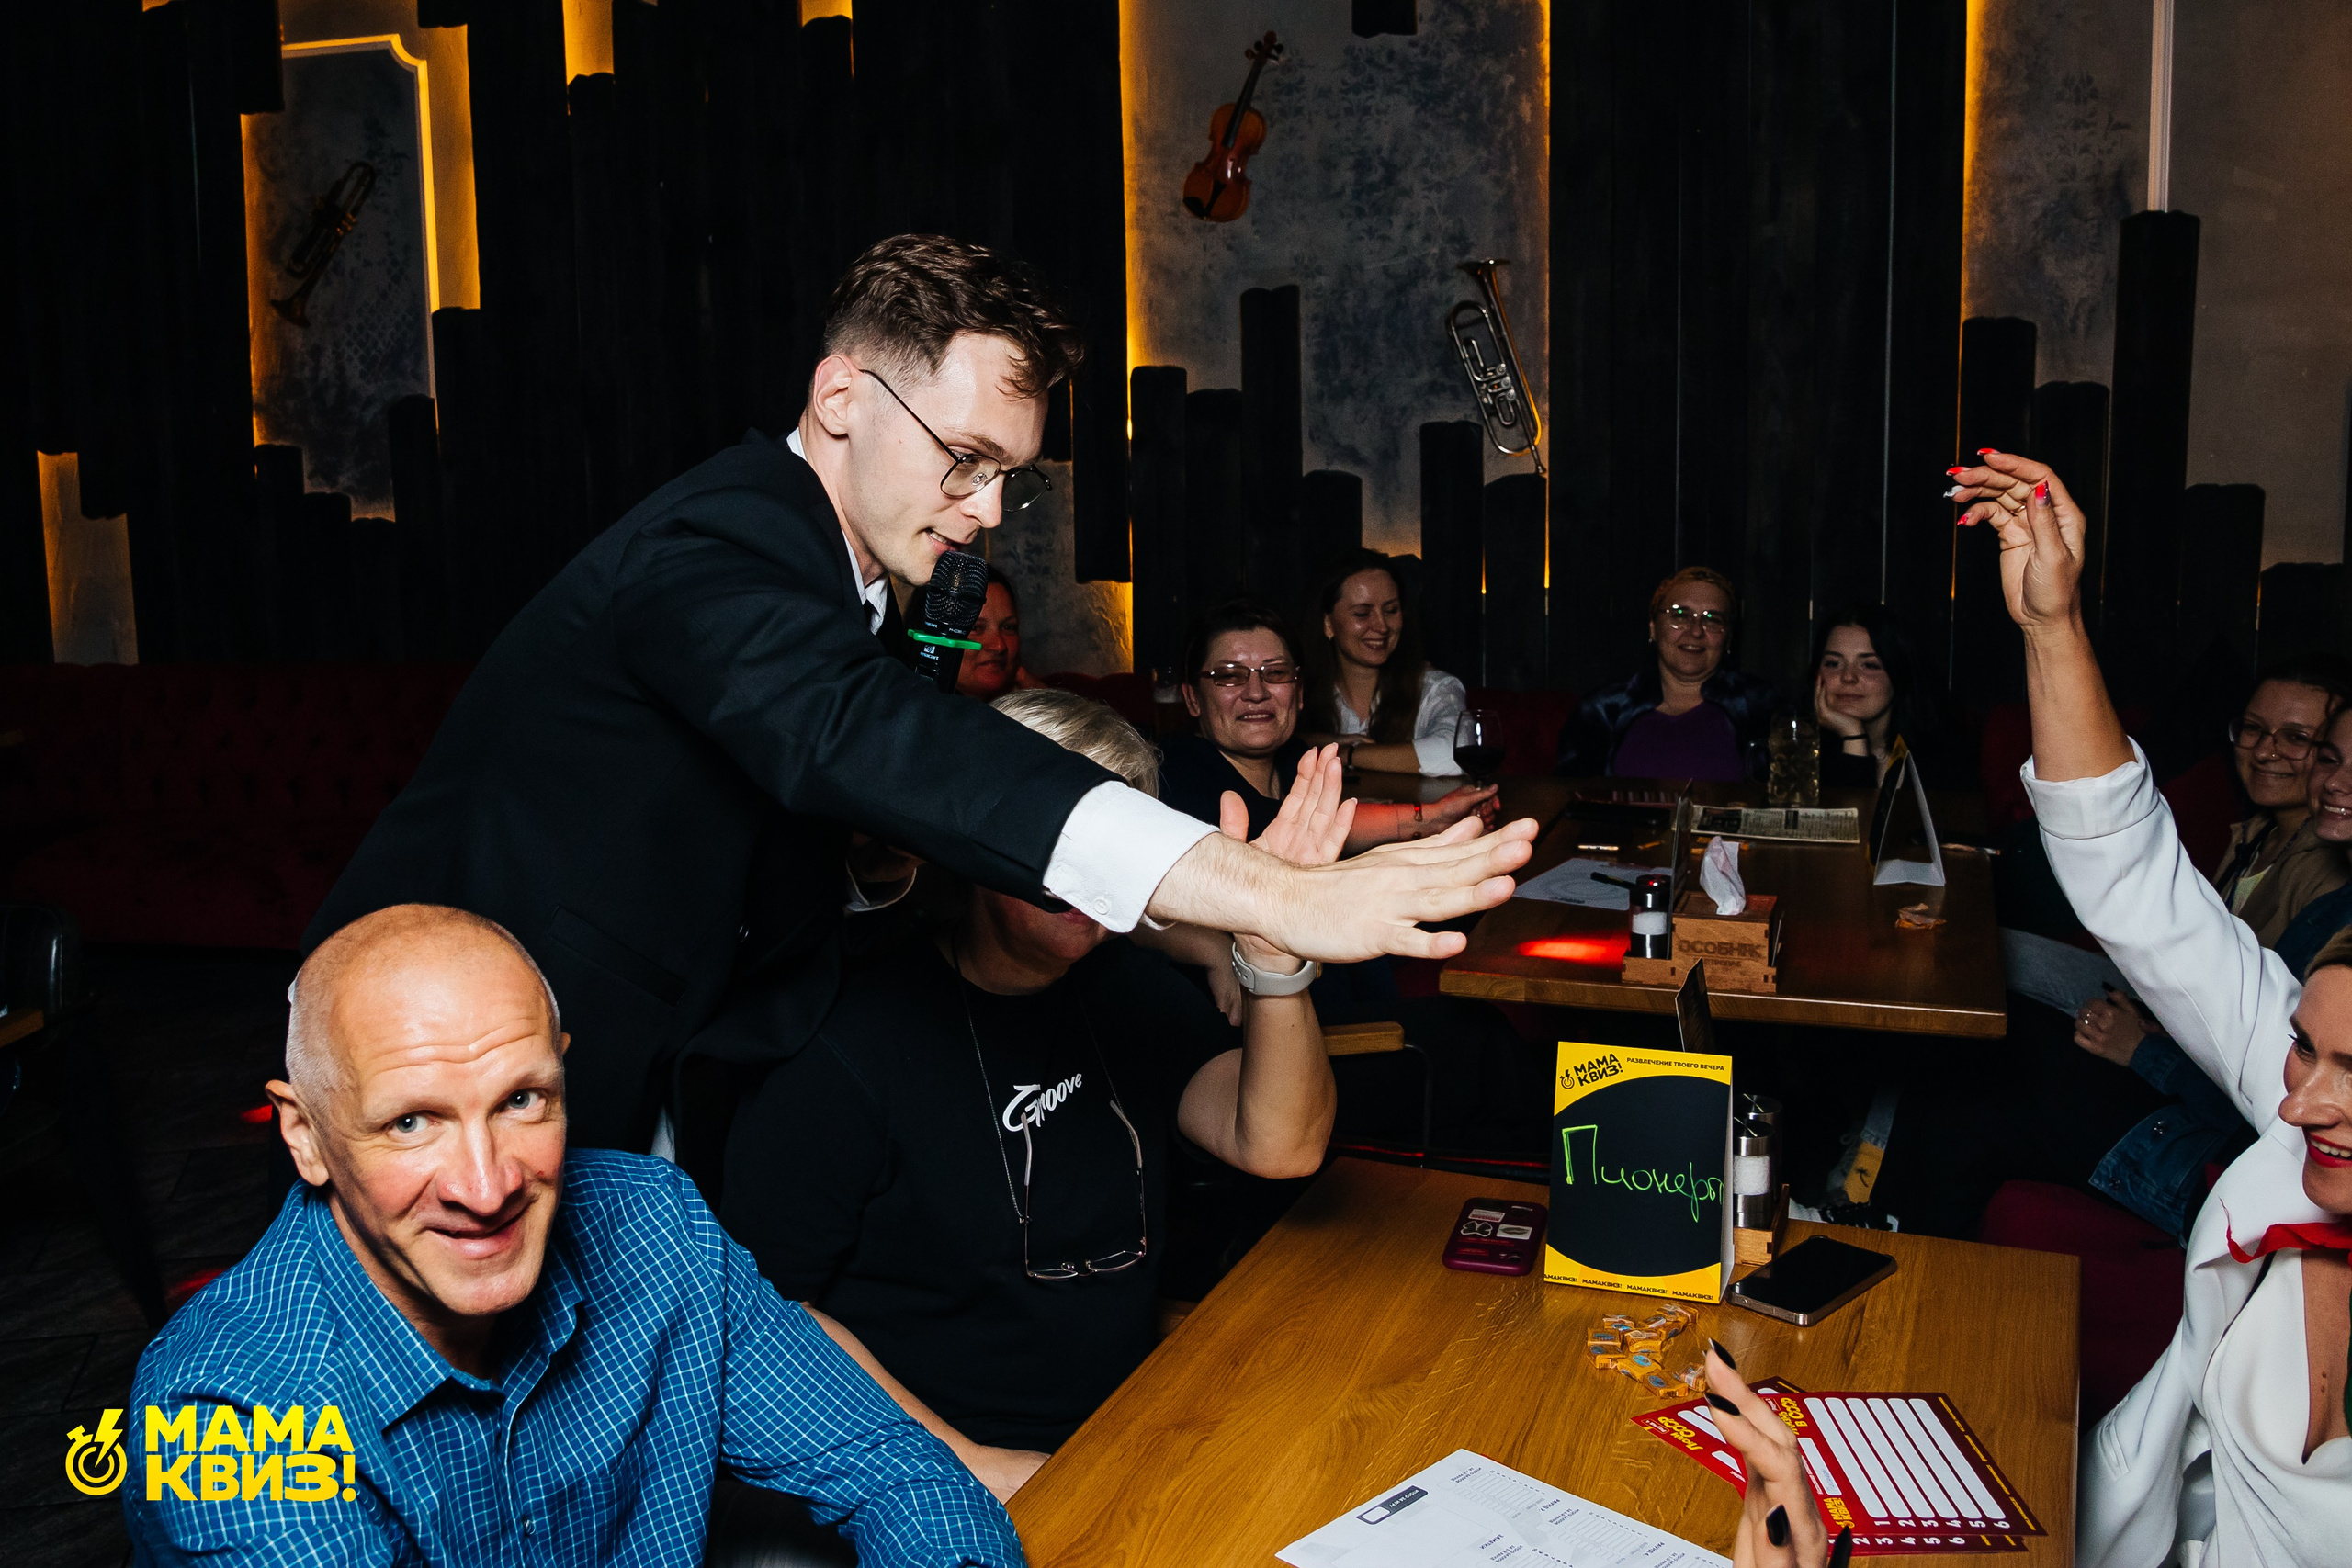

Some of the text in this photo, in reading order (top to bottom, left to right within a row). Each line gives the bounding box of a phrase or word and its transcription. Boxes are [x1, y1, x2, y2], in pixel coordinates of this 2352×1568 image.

[1573, 1053, 1620, 1076] МАМА
[1626, 1057, 1672, 1066] РАЗВЛЕЧЕНИЕ
[1673, 1061, 1699, 1069] ТВОЕГО
[1577, 1063, 1624, 1087] КВИЗ!
[1582, 1279, 1622, 1289] МАМАКВИЗ!
[1627, 1284, 1668, 1294] МАМАКВИЗ!
[1672, 1290, 1713, 1300] МАМАКВИЗ!
[1781, 1397, 1804, 1419] СССР
[1657, 1416, 1696, 1438] СССР
[1823, 1497, 1843, 1520] МАМА
[1900, 1537, 1916, 1545] 4
[1948, 1537, 1965, 1545] 6
